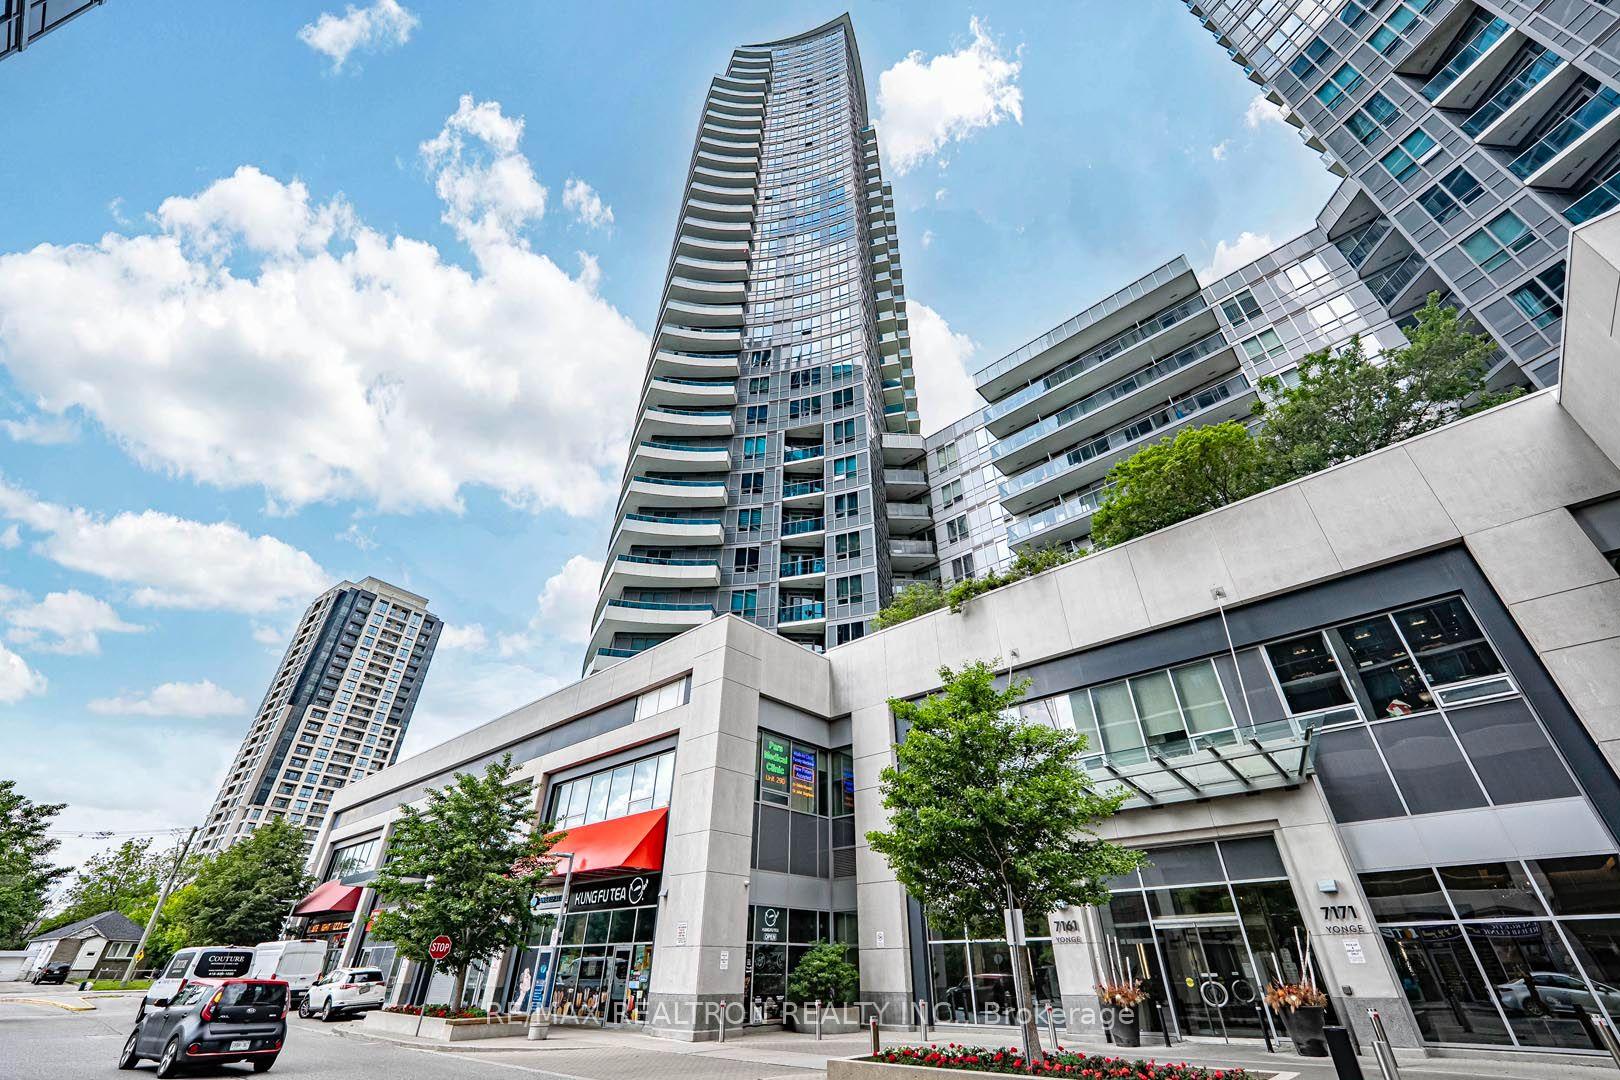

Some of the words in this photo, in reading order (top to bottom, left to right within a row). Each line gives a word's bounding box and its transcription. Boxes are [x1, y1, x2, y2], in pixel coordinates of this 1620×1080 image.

[763, 750, 788, 764] Medical
[765, 762, 785, 775] Clinic
[610, 887, 627, 902] TEA
[1319, 905, 1358, 920] 7171
[1053, 920, 1078, 932] 7161
[1325, 924, 1365, 935] YONGE
[430, 942, 450, 952] STOP
[208, 955, 246, 963] COUTURE
